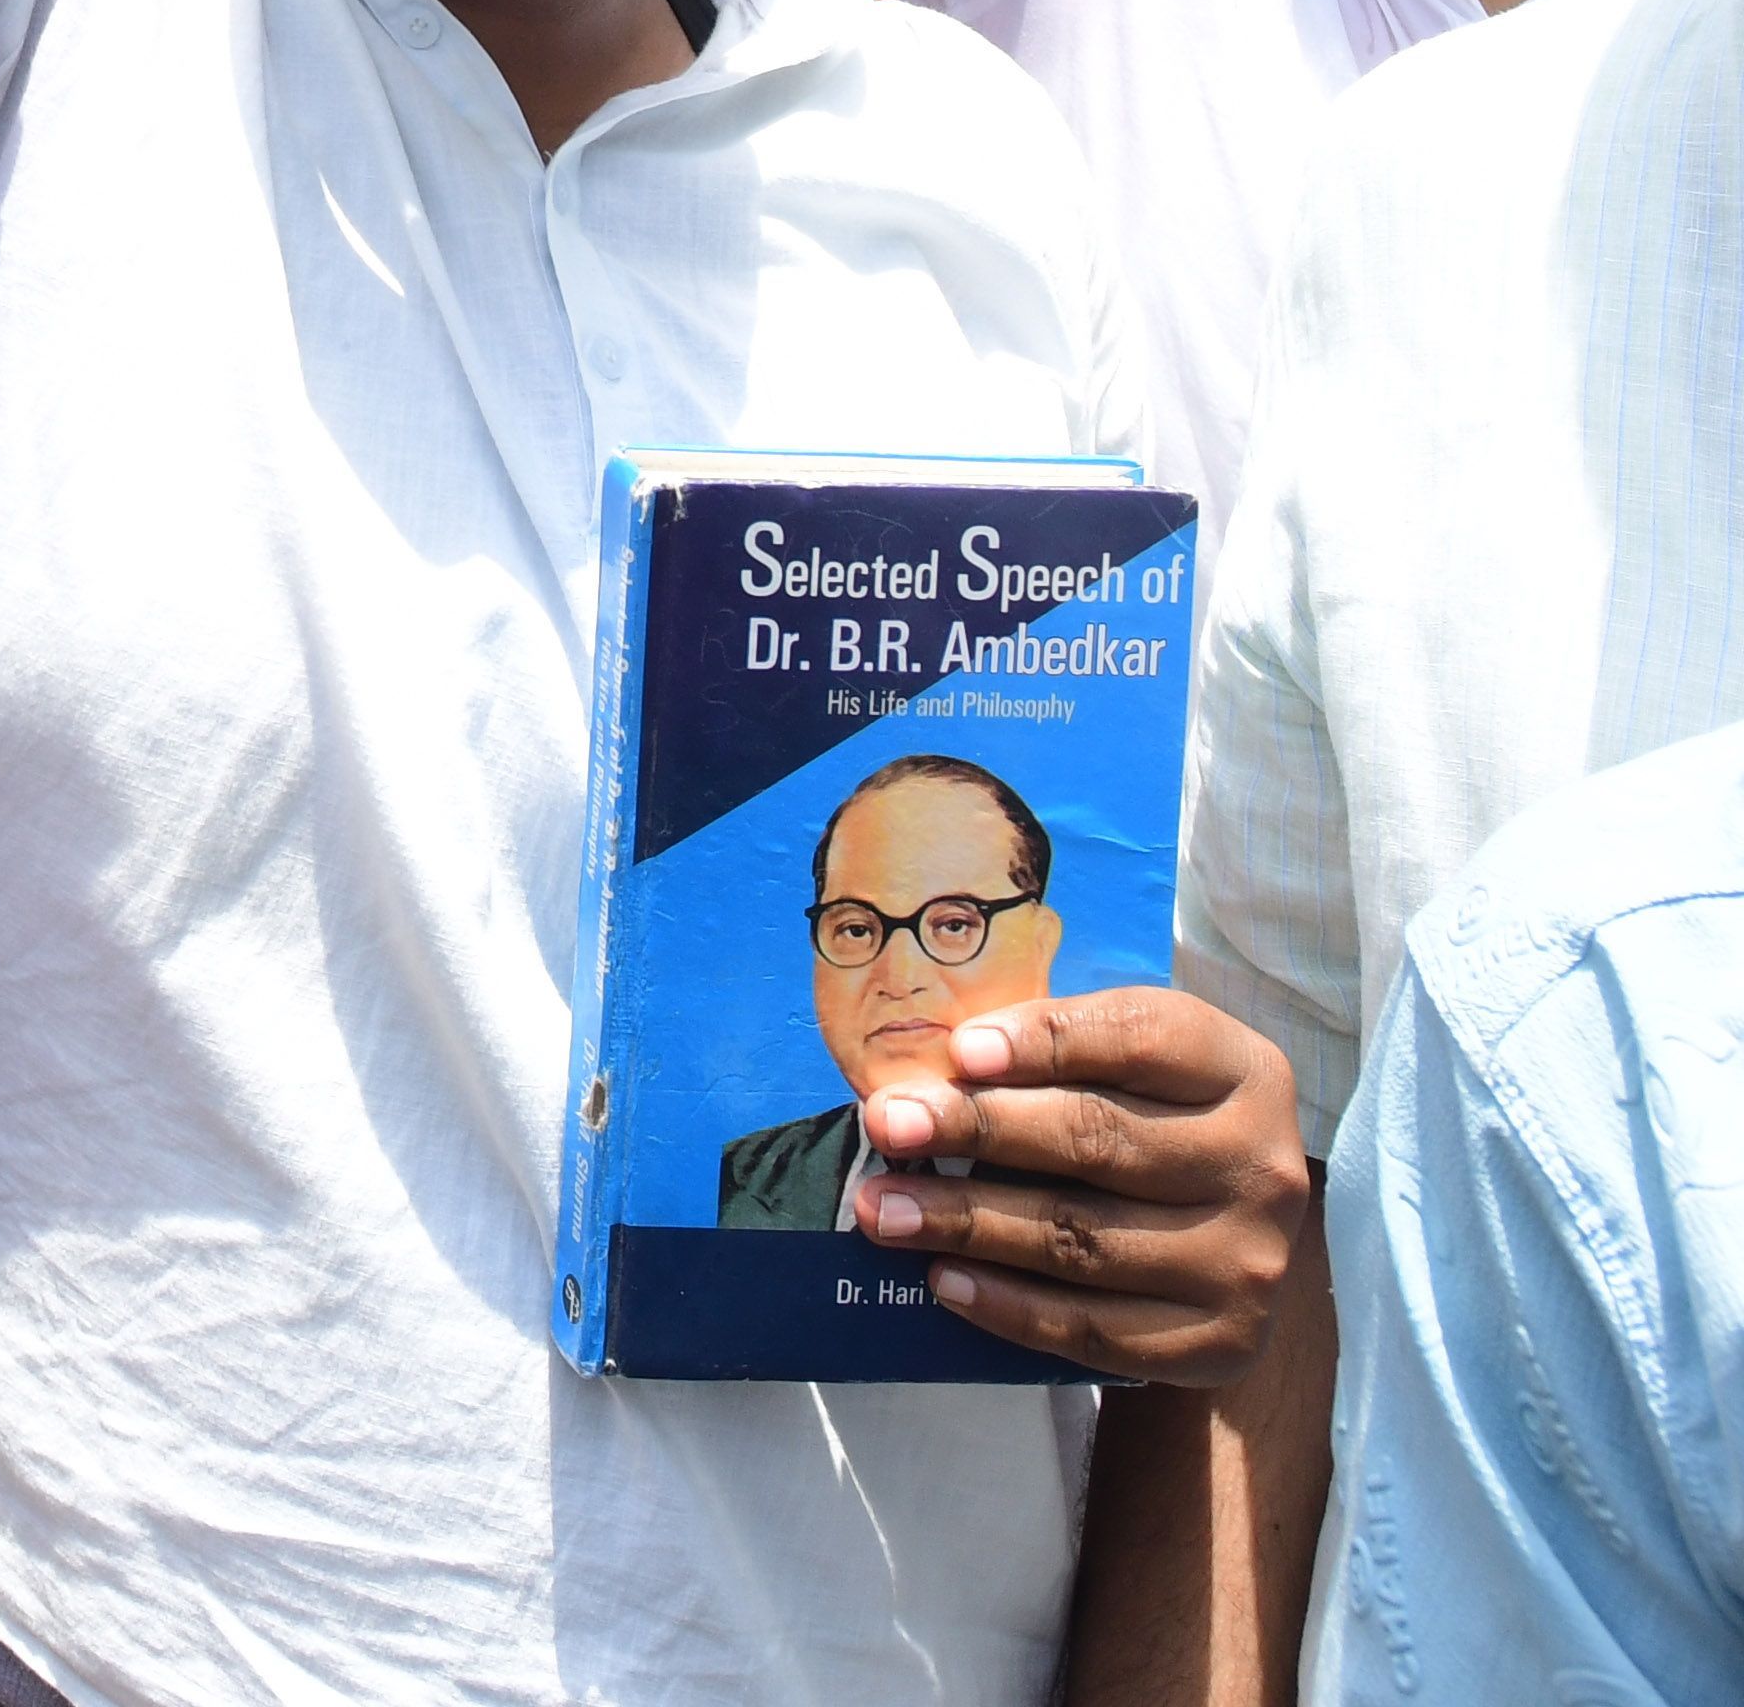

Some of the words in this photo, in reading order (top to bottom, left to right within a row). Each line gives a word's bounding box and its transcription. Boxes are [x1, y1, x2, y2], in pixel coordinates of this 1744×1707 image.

[740, 520, 939, 600] Selected
[956, 524, 1125, 613] Speech
[1141, 553, 1185, 604] of
[746, 617, 811, 672] Dr.
[829, 619, 922, 674] B.R.
[940, 619, 1167, 679] Ambedkar
[827, 689, 861, 717] His
[868, 689, 909, 719] Life
[915, 692, 956, 720] and
[961, 691, 1076, 725] Philosophy
[570, 1152, 589, 1243] Sharma
[836, 1279, 869, 1306] Dr.
[877, 1278, 924, 1306] Hari
